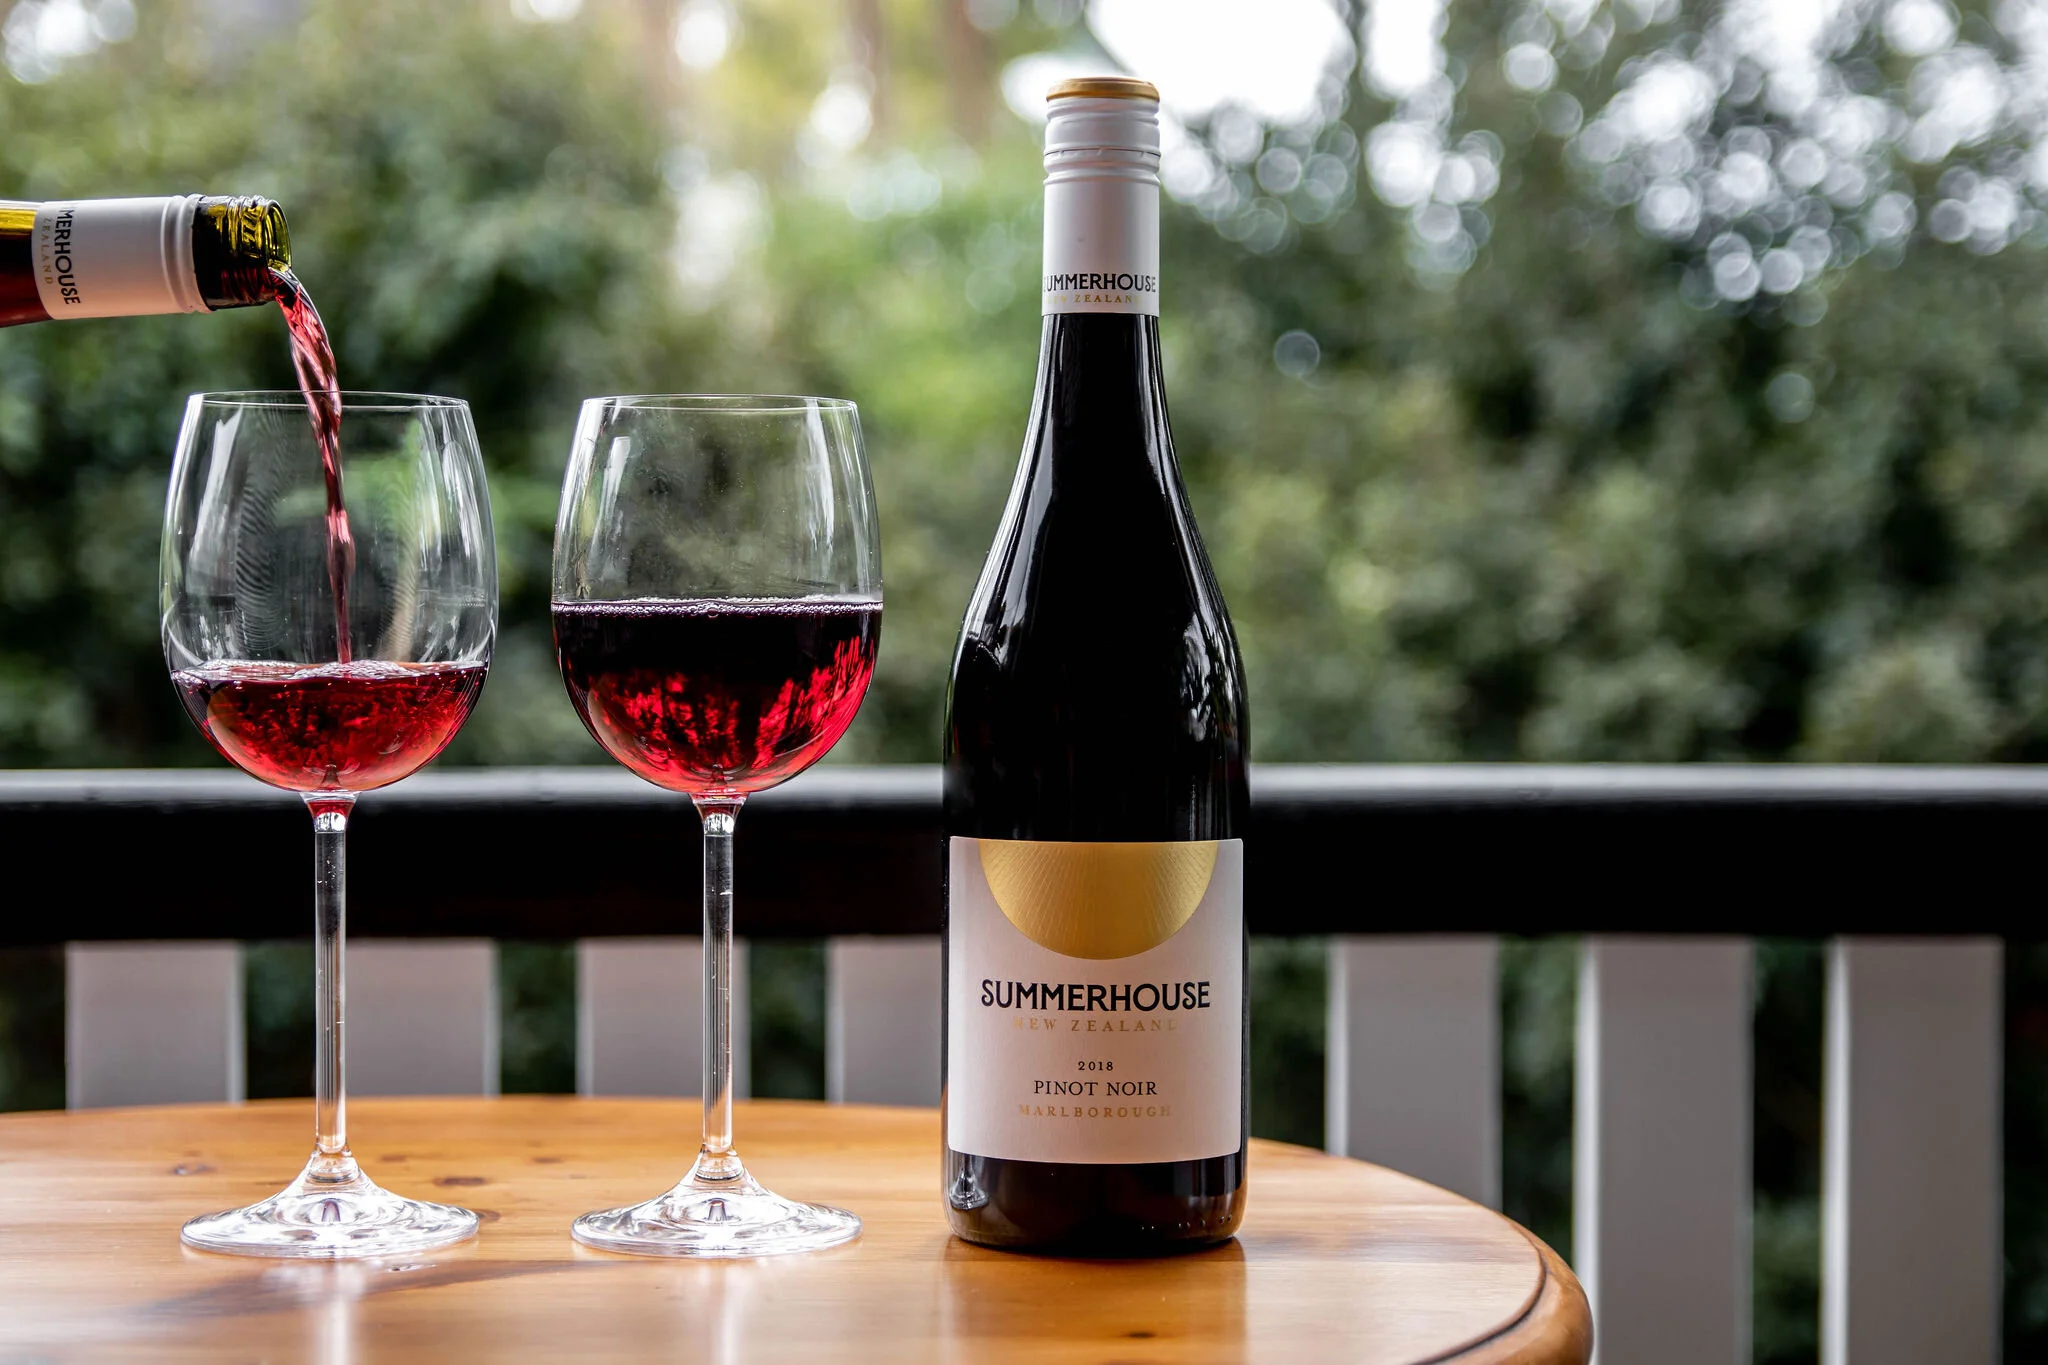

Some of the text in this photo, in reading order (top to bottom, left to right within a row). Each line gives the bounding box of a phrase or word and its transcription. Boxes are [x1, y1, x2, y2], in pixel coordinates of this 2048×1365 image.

[54, 207, 81, 305] MERHOUSE
[1043, 273, 1156, 293] UMMERHOUSE
[980, 979, 1211, 1012] SUMMERHOUSE
[1012, 1016, 1178, 1032] NEW ZEALAND
[1077, 1060, 1114, 1072] 2018
[1033, 1080, 1158, 1096] PINOT NOIR
[1019, 1104, 1171, 1119] MARLBOROUGH
